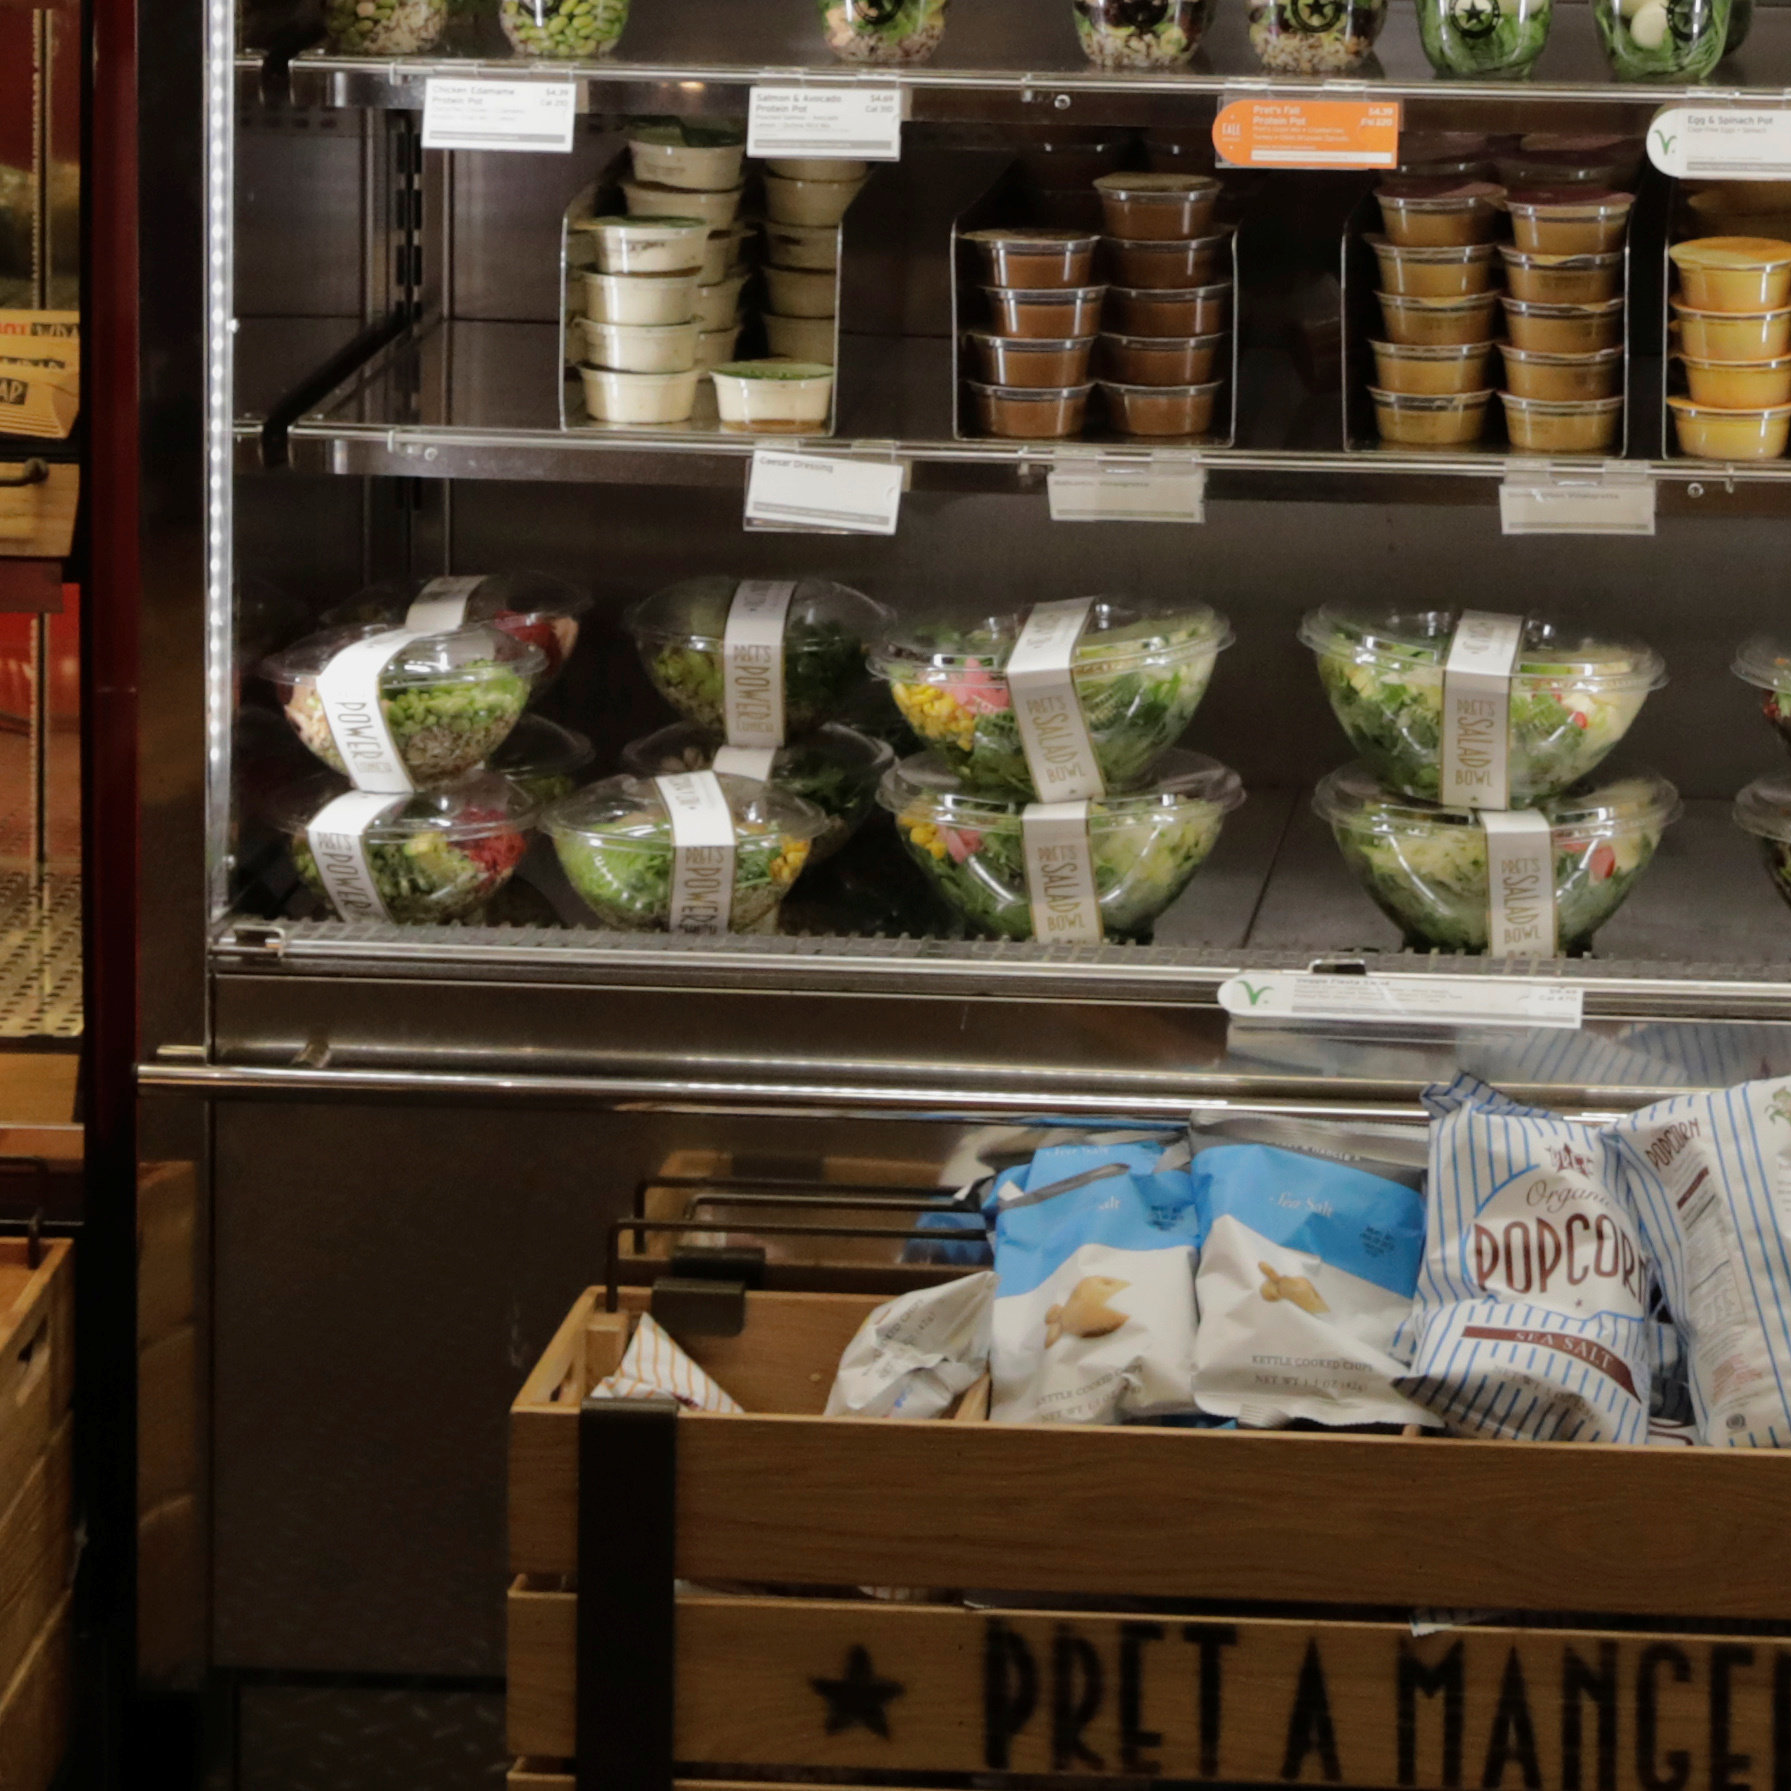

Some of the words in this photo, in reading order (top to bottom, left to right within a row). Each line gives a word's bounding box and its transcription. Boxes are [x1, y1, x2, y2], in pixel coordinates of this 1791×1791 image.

[470, 87, 515, 97] Edamame
[756, 93, 791, 103] Salmon
[803, 94, 843, 104] Avocado
[755, 103, 790, 113] Protein
[792, 104, 808, 113] Pot
[1253, 116, 1289, 126] Protein
[1291, 116, 1307, 126] Pot
[1688, 115, 1704, 127] Egg
[1718, 115, 1754, 127] Spinach
[1757, 115, 1773, 125] Pot
[759, 455, 792, 467] Caesar
[793, 458, 834, 474] Dressing
[734, 666, 772, 720] POWER
[335, 701, 386, 760] POWER
[1031, 712, 1079, 765] SALAD
[1456, 717, 1495, 769] SALAD
[1047, 765, 1085, 784] BOWL
[1455, 769, 1493, 787] BOWL
[322, 852, 372, 917] POWER
[1041, 862, 1081, 913] SALAD
[679, 867, 722, 924] POWER
[1502, 875, 1540, 925] SALAD
[1048, 914, 1086, 931] BOWL
[1504, 926, 1542, 946] BOWL
[1644, 1116, 1703, 1172] POPCORN
[1304, 1195, 1335, 1216] Salt
[1515, 1329, 1556, 1346] SEA
[1562, 1333, 1614, 1371] SALT
[1251, 1354, 1293, 1368] KETTLE
[1295, 1357, 1341, 1372] COOKED
[983, 1617, 1238, 1778] PRET
[1279, 1635, 1342, 1783] A
